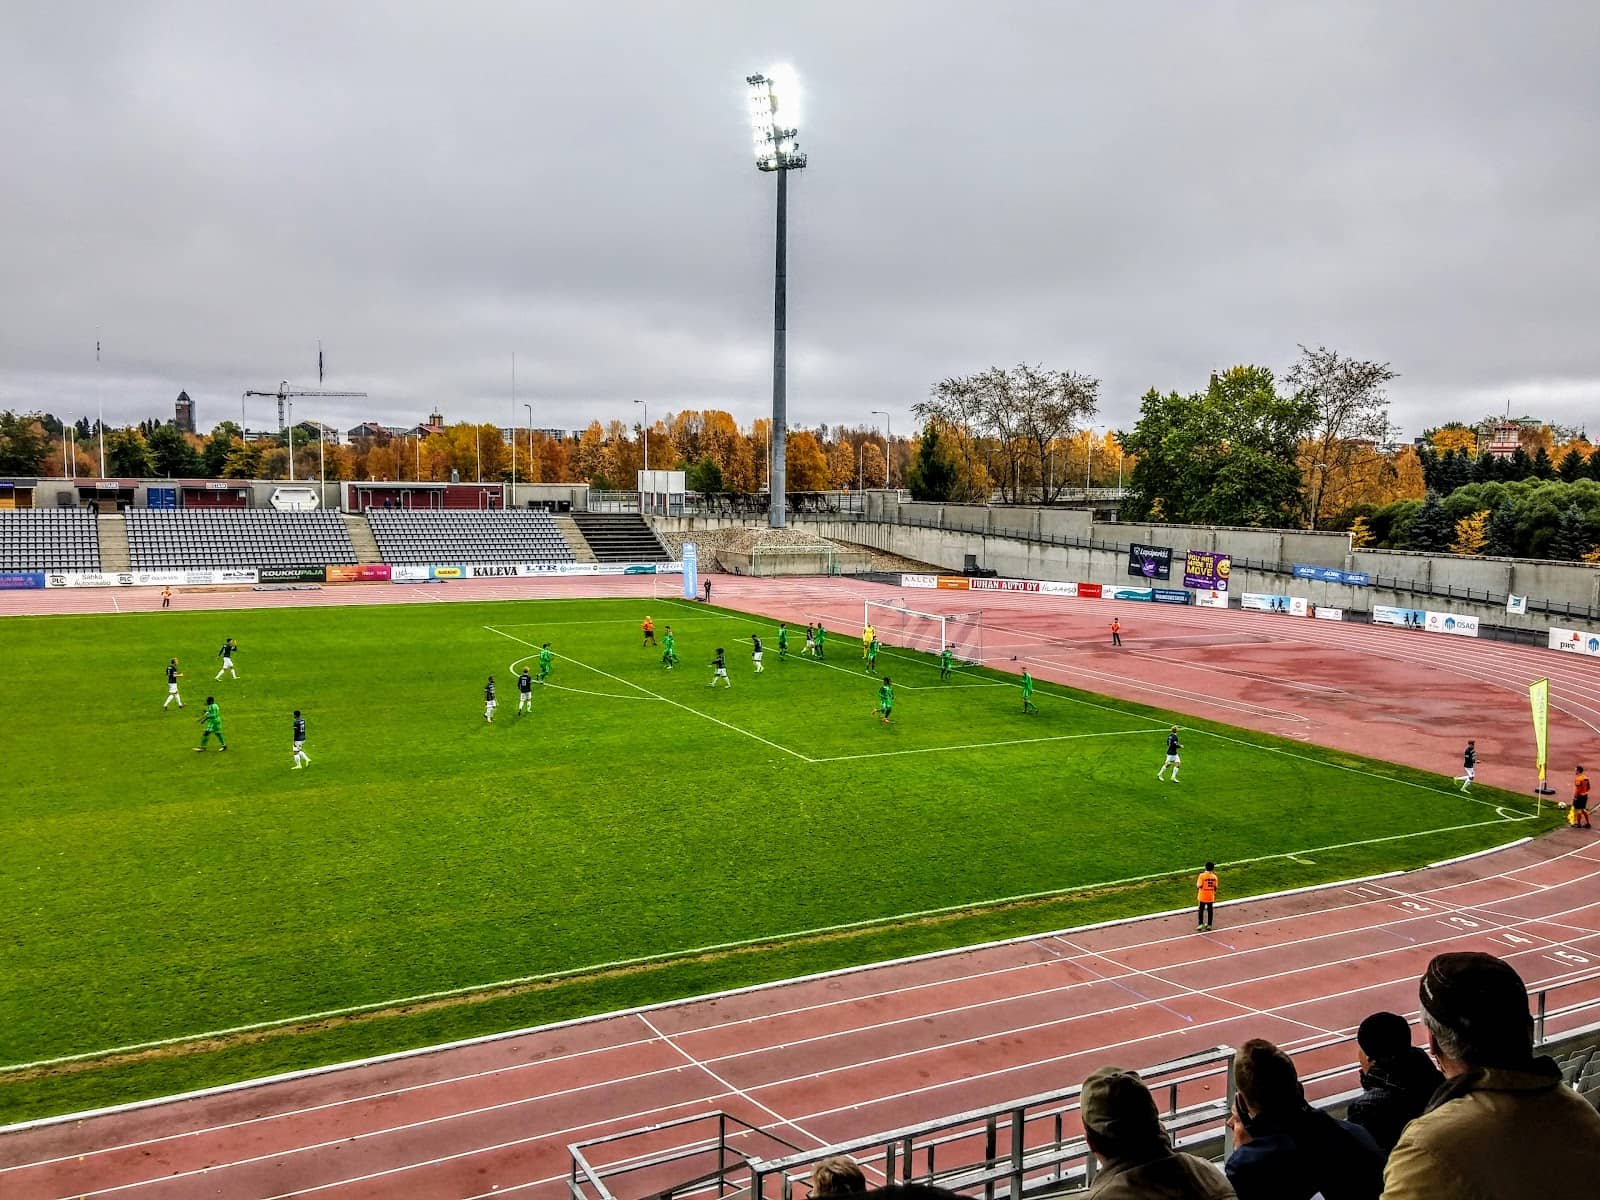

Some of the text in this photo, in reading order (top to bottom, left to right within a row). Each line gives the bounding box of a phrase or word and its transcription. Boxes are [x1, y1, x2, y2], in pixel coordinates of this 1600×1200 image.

[261, 568, 324, 577] KOUKKUPAJA
[473, 566, 518, 577] KALEVA
[1187, 566, 1213, 577] MOVE
[973, 579, 1000, 589] JUHAN
[1002, 581, 1025, 591] AUTO
[1026, 583, 1038, 592] OY
[1456, 621, 1476, 630] OSAO
[1560, 641, 1576, 650] pwc
[1401, 901, 1431, 912] 2
[1449, 917, 1479, 928] 3
[1502, 933, 1534, 945] 4
[1553, 950, 1589, 963] 5
